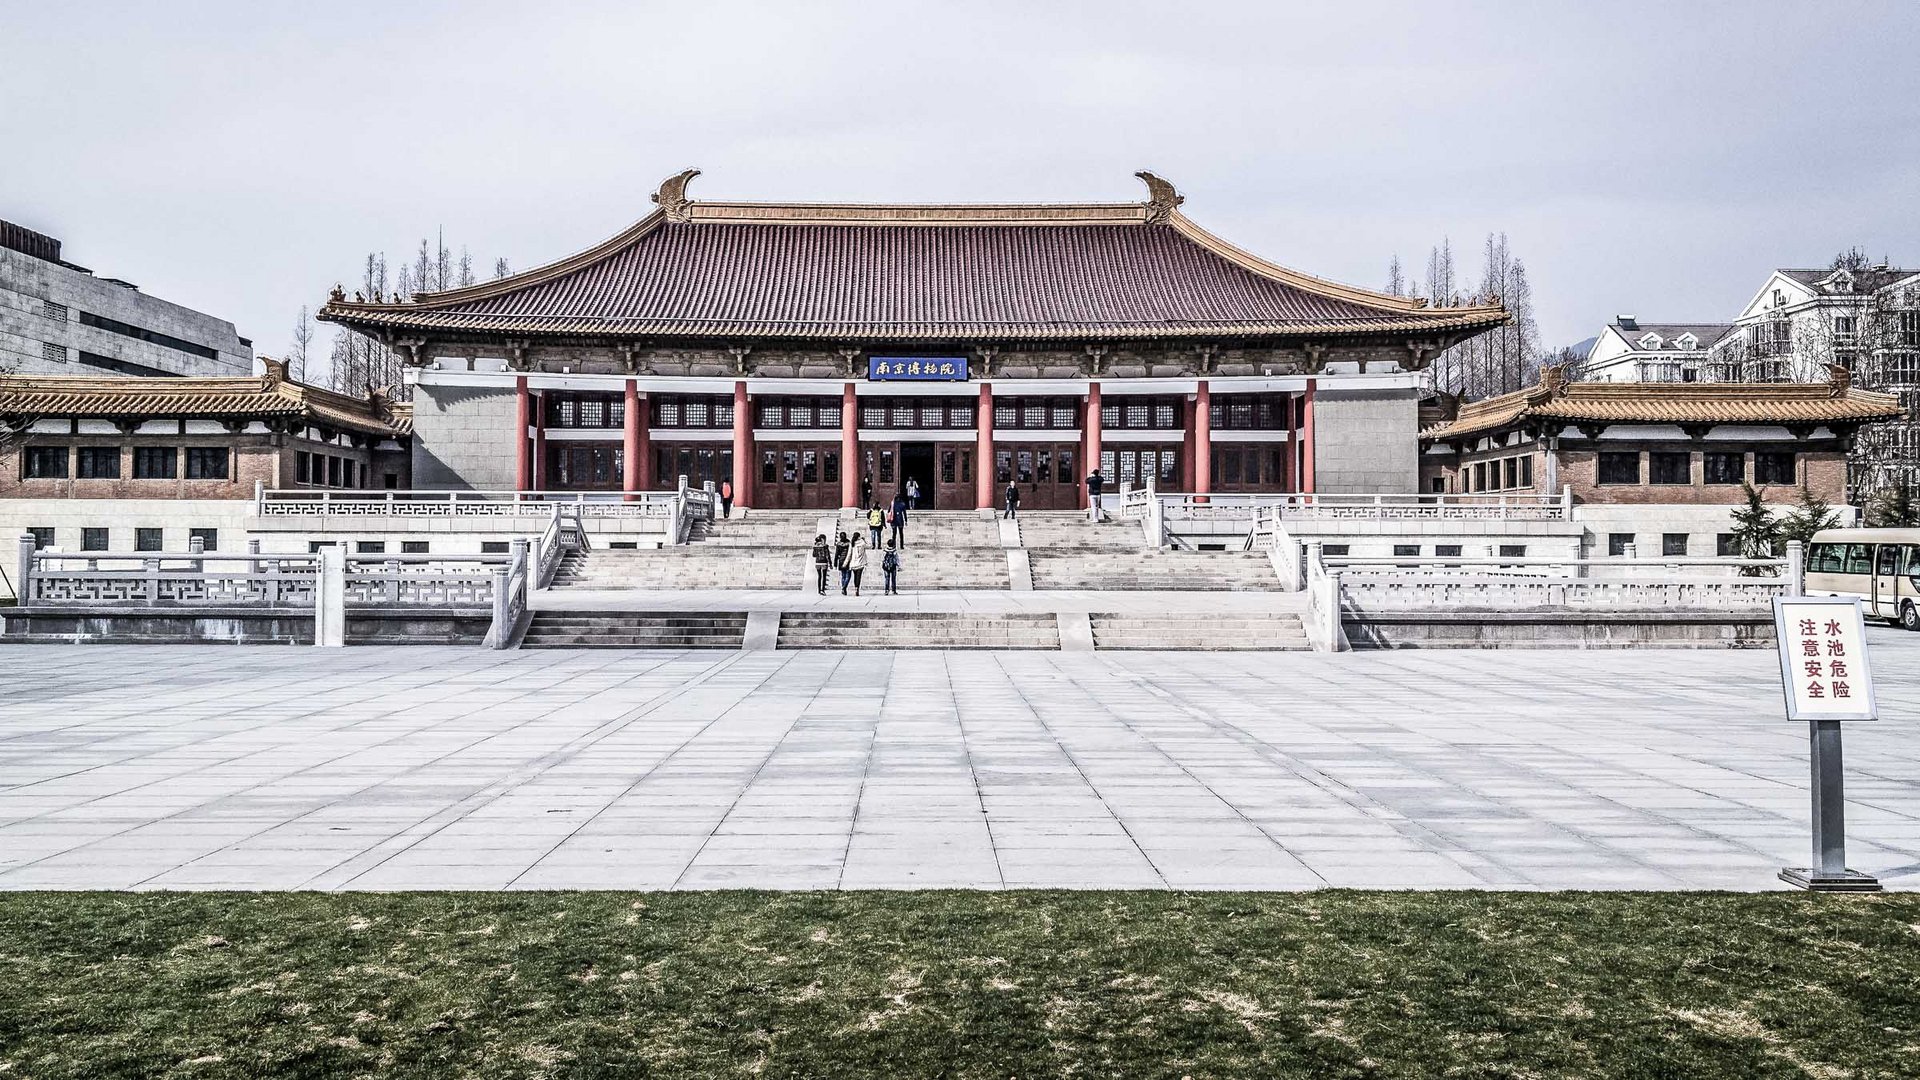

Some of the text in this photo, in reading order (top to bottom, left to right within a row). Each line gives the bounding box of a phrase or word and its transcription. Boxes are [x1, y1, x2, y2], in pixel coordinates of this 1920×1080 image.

[876, 361, 955, 375] 南京博物院
[1799, 618, 1825, 698] 注意安全
[1824, 618, 1851, 698] 水池危险
